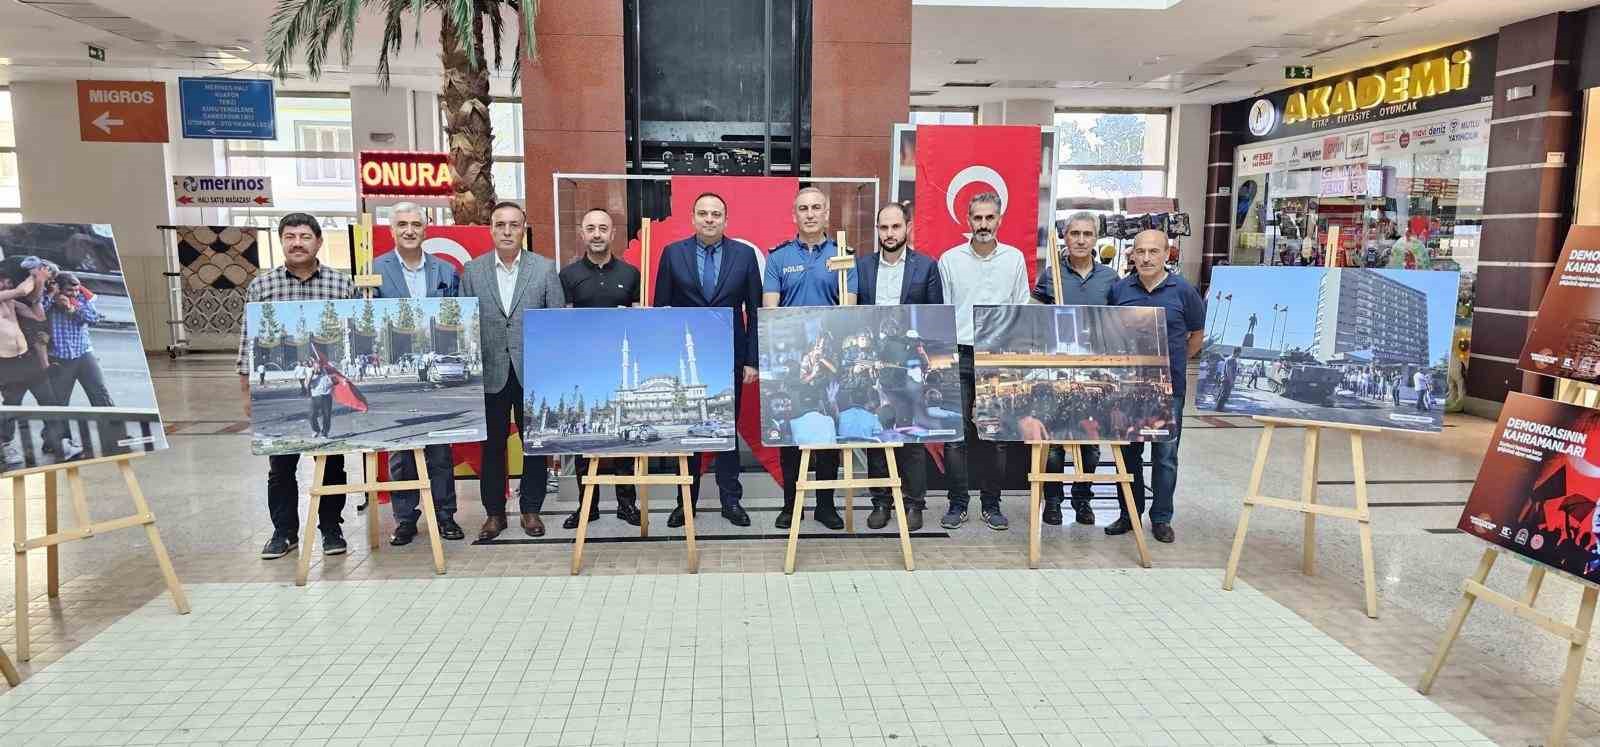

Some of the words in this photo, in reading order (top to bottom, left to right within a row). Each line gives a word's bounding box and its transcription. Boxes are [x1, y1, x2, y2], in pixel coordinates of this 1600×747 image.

[89, 89, 154, 104] MIGROS
[1379, 102, 1418, 117] OYUNCAK
[200, 177, 264, 191] merinos
[1502, 429, 1587, 458] KAHRAMANLARI
